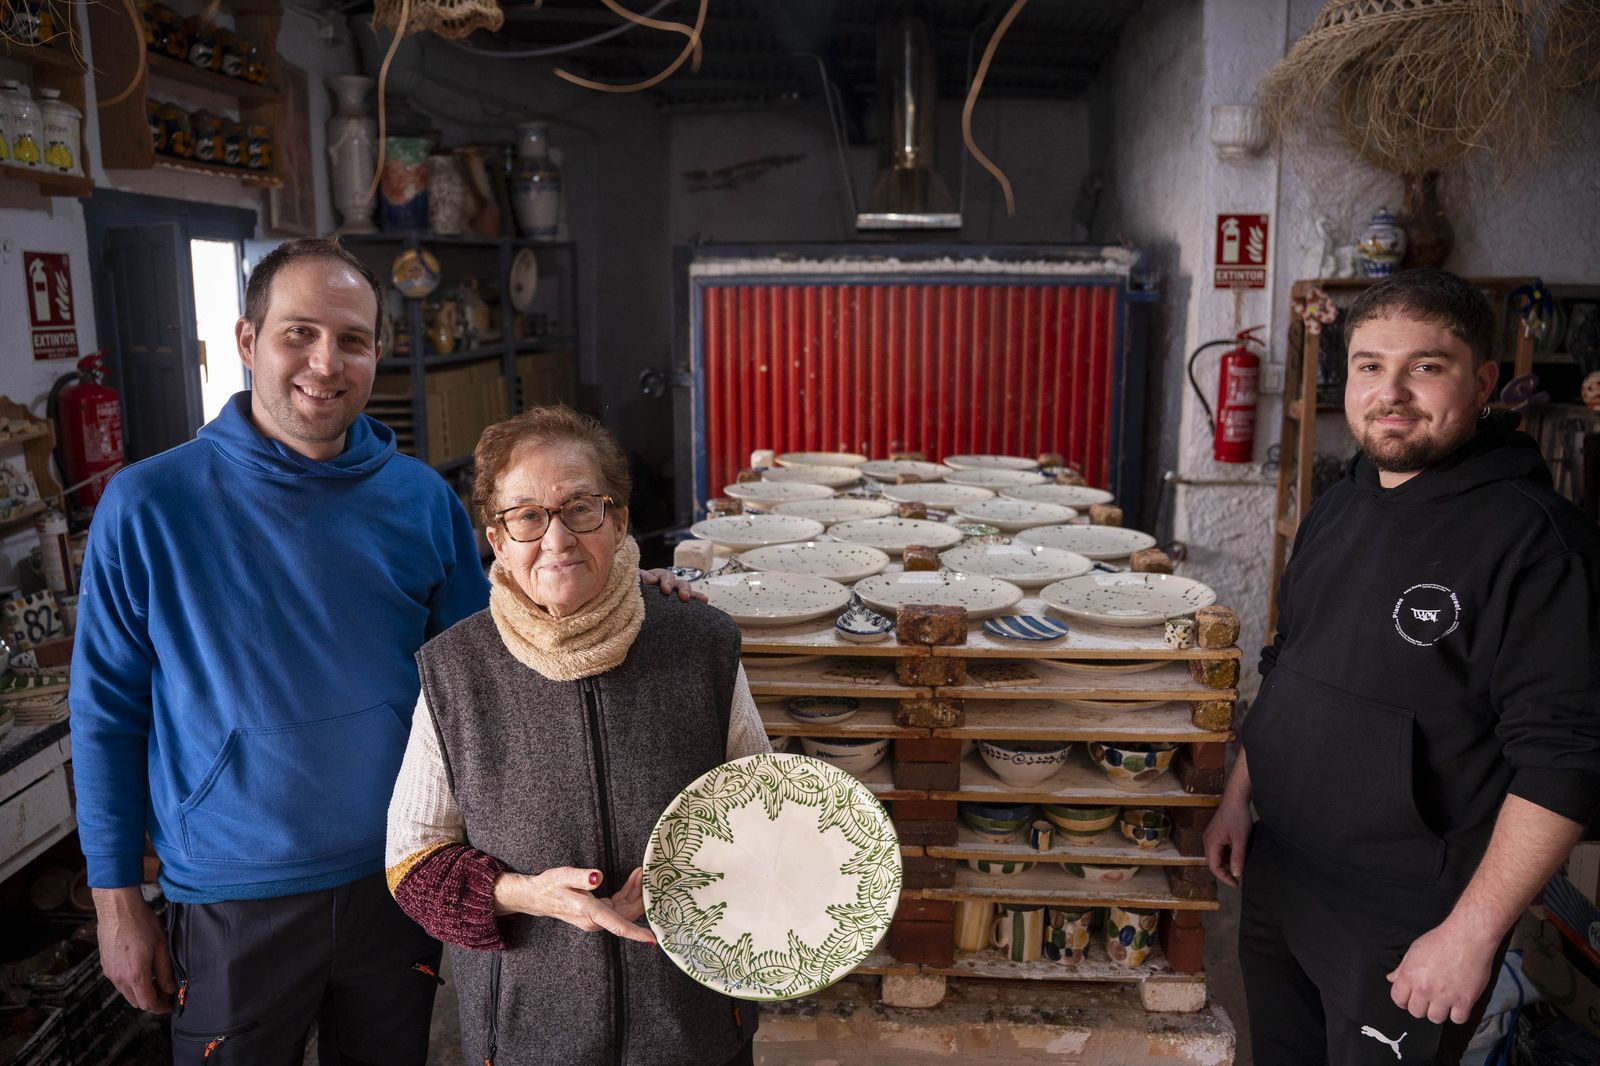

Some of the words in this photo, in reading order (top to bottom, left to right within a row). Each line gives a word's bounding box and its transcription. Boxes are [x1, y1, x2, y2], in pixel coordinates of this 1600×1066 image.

[1216, 271, 1264, 281] EXTINTOR
[34, 333, 77, 348] EXTINTOR
[1392, 598, 1404, 619] Places
[24, 605, 60, 643] 82
